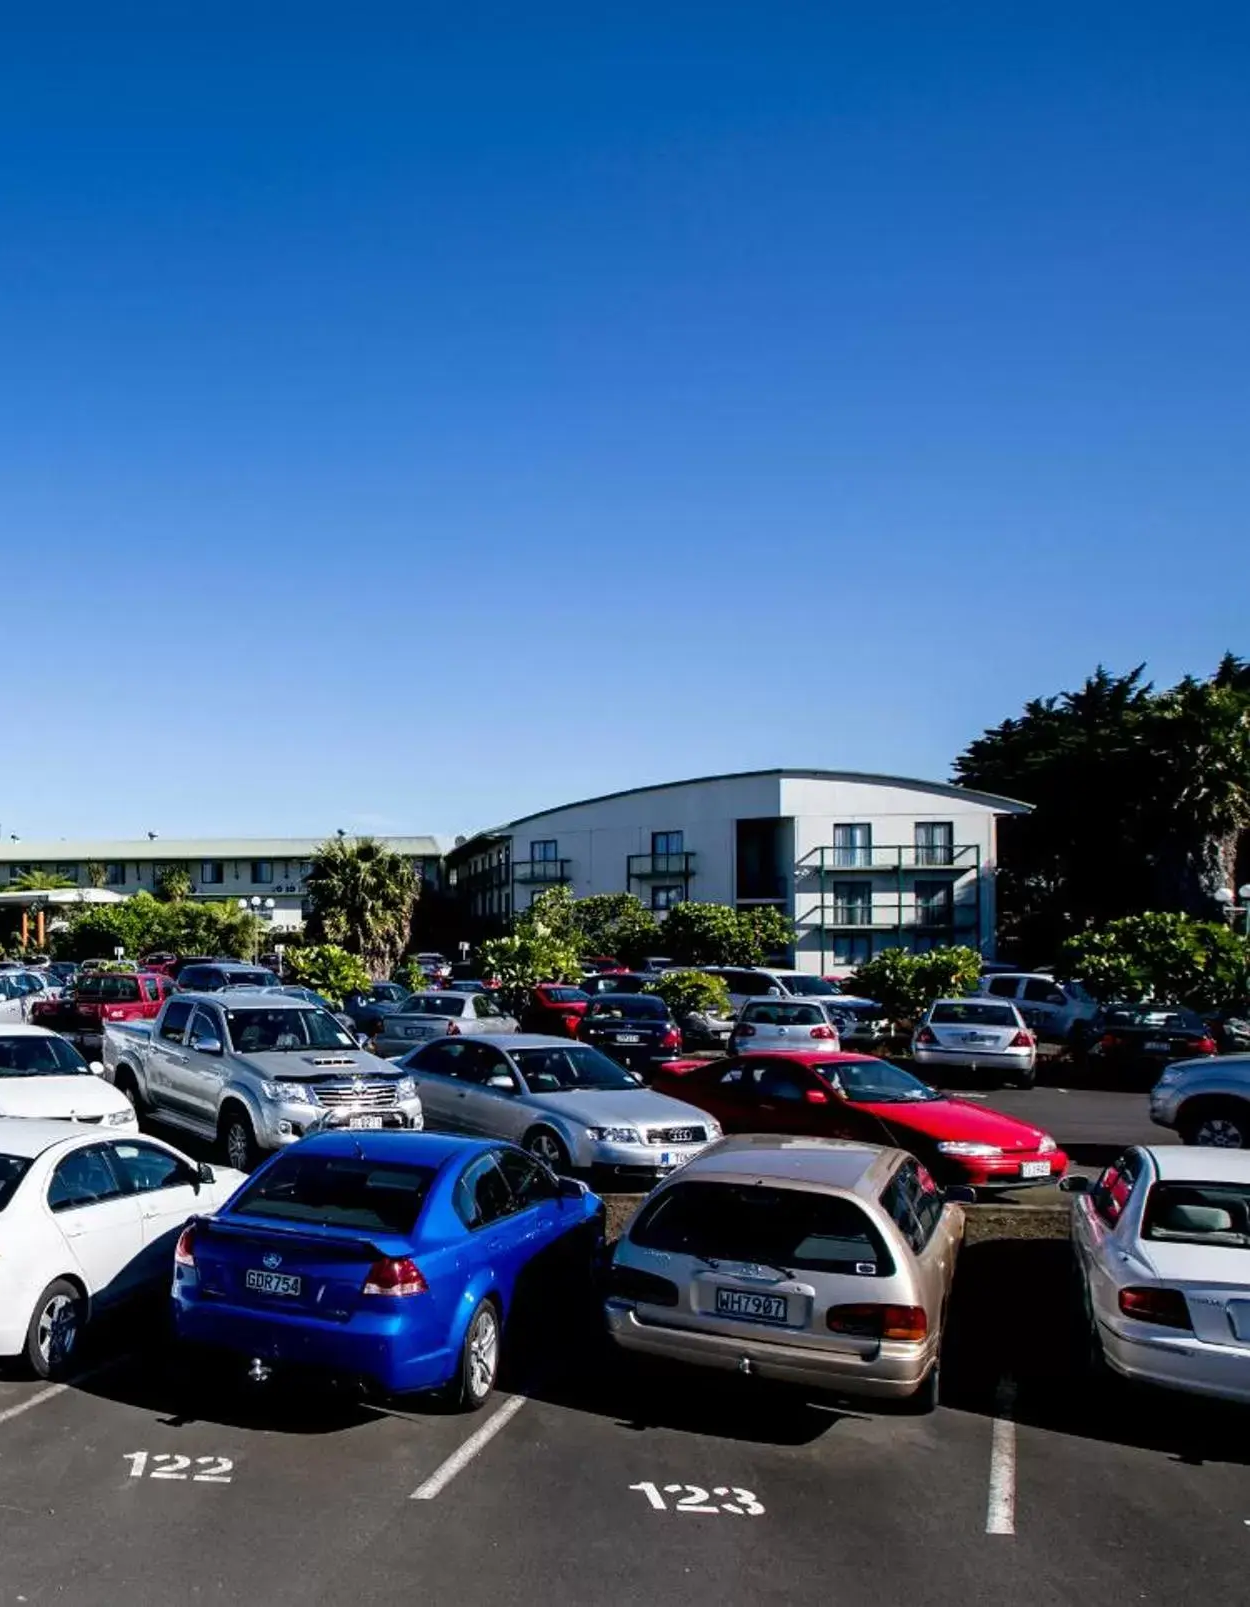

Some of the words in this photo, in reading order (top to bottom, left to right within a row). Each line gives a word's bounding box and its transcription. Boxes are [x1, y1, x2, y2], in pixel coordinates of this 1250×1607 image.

[247, 1271, 299, 1294] GDR754
[719, 1291, 783, 1318] WH7907
[123, 1451, 233, 1482] 122
[629, 1481, 766, 1515] 123
